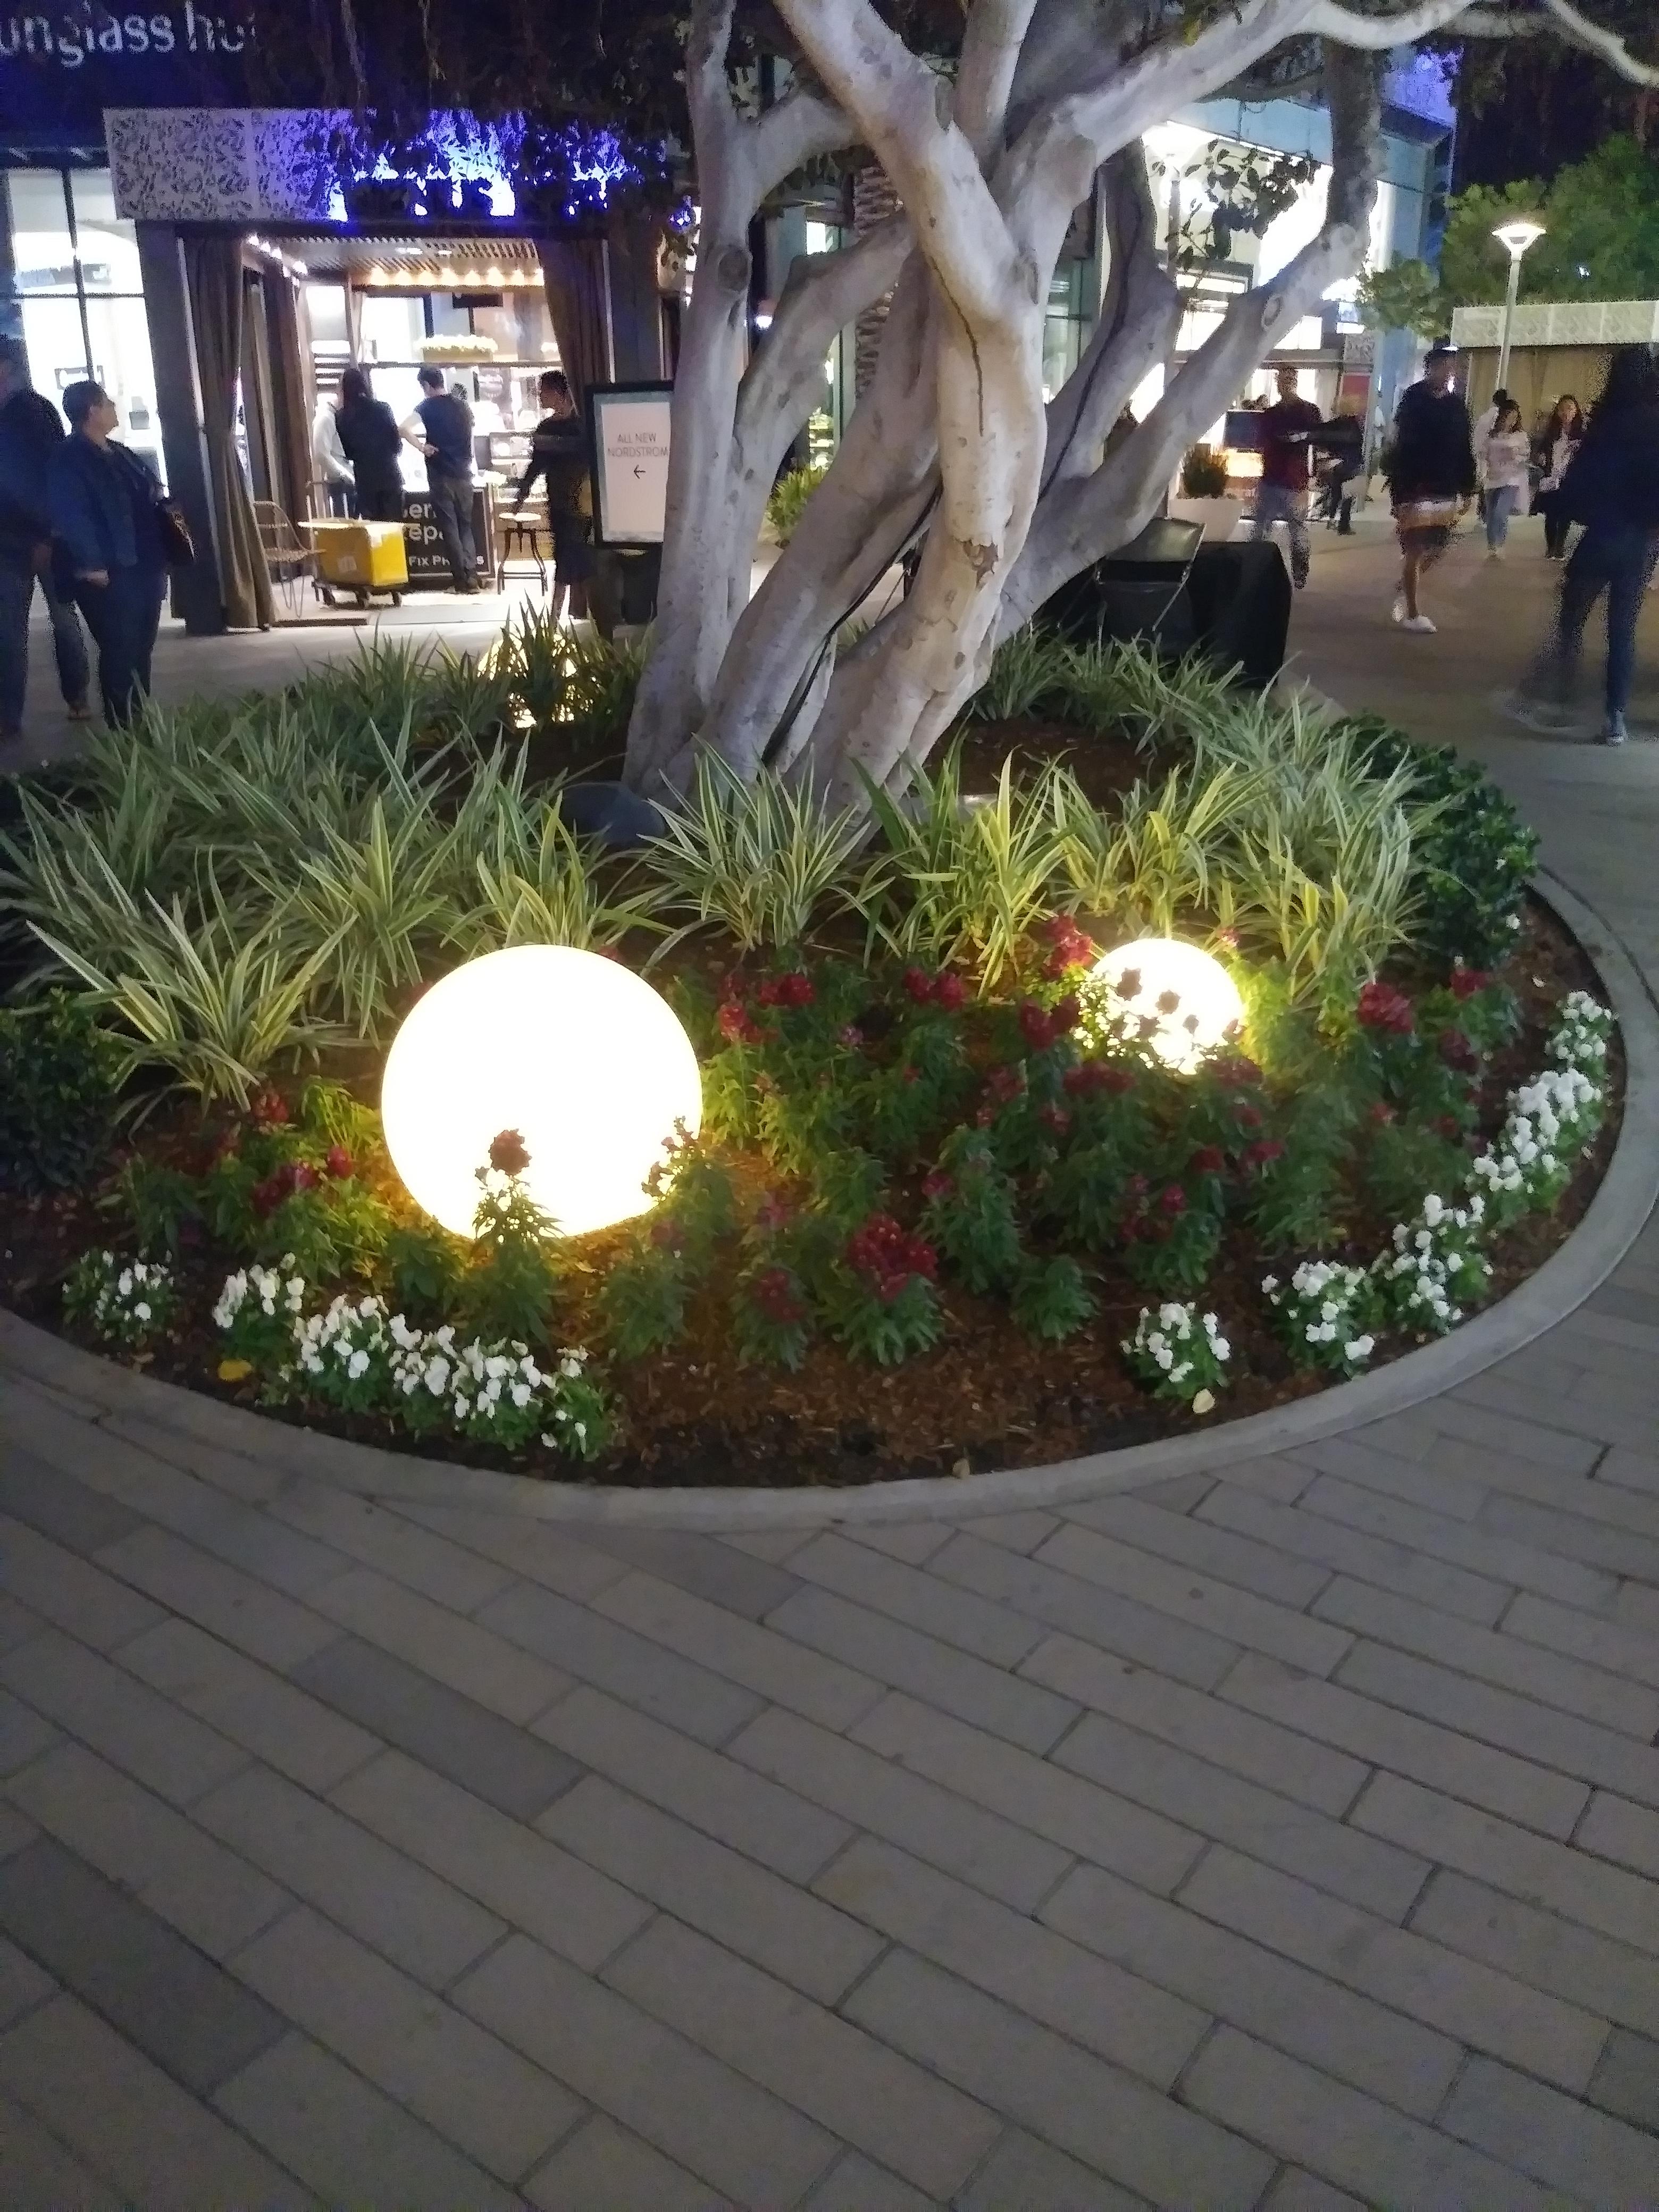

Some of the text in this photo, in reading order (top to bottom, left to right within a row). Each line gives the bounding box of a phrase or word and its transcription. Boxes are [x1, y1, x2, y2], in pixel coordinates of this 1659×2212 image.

[184, 0, 257, 53] hu
[617, 432, 656, 443] ALL NEW
[607, 446, 669, 457] NORDSTROM
